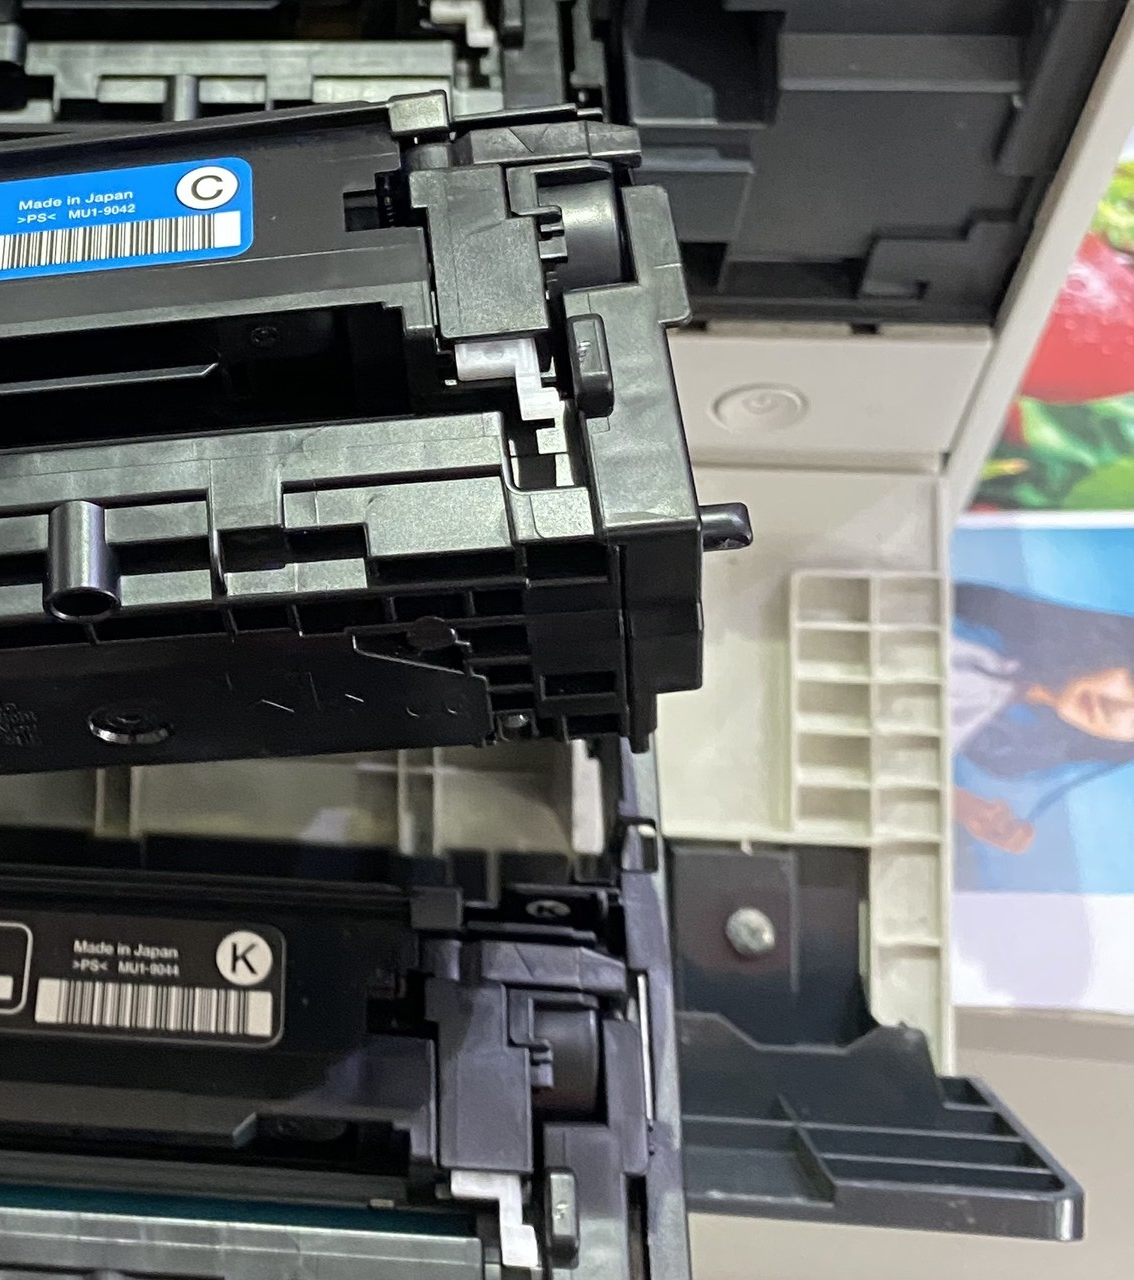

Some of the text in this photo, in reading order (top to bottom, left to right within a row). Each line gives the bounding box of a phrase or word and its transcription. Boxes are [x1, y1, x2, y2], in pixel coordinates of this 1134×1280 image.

[190, 174, 224, 201] C
[18, 190, 134, 212] Made in Japan
[17, 204, 136, 224] >PS< MU1-9042
[73, 939, 179, 960] Made in Japan
[229, 941, 259, 975] K
[72, 958, 109, 972] >PS<
